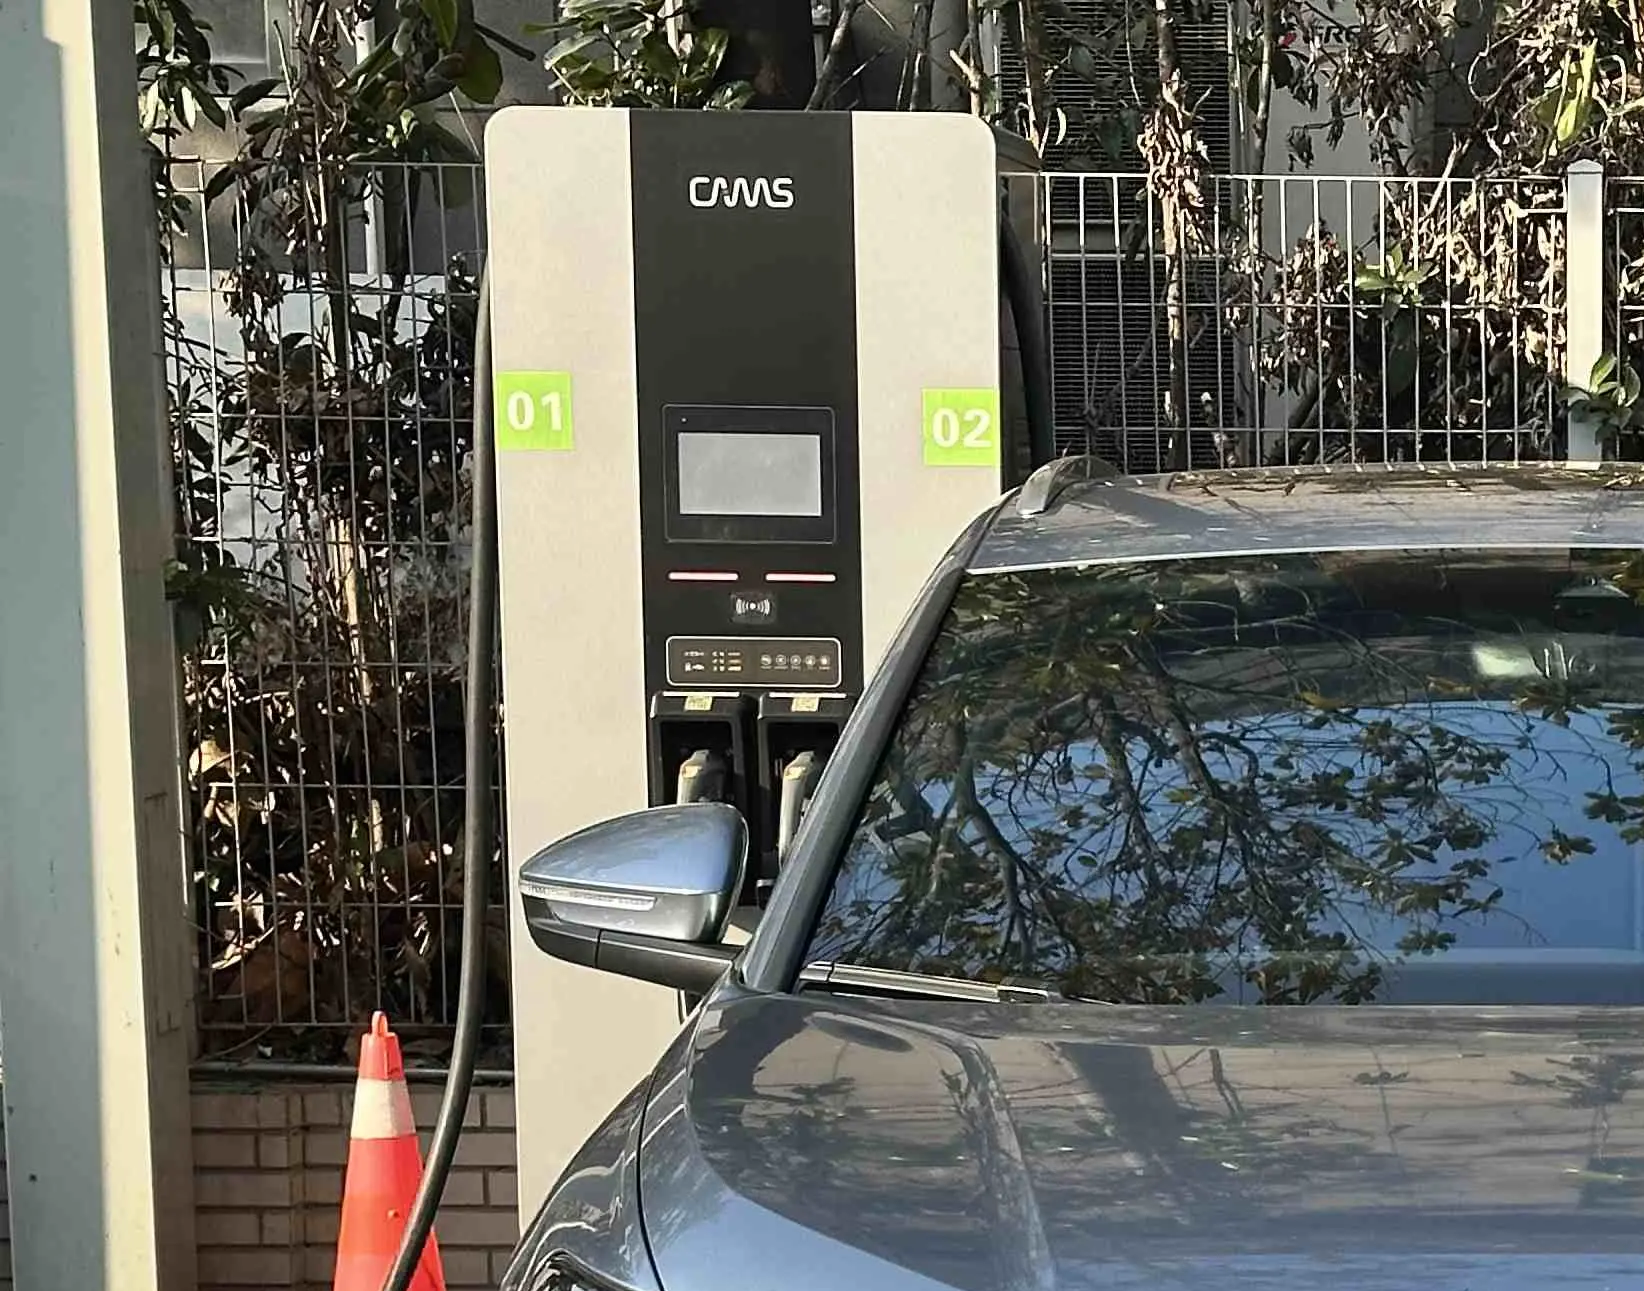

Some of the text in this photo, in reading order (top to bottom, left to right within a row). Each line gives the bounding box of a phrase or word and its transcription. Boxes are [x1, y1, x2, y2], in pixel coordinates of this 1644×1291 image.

[689, 176, 795, 209] CAMS
[506, 390, 564, 432] 01
[931, 408, 994, 449] 02
